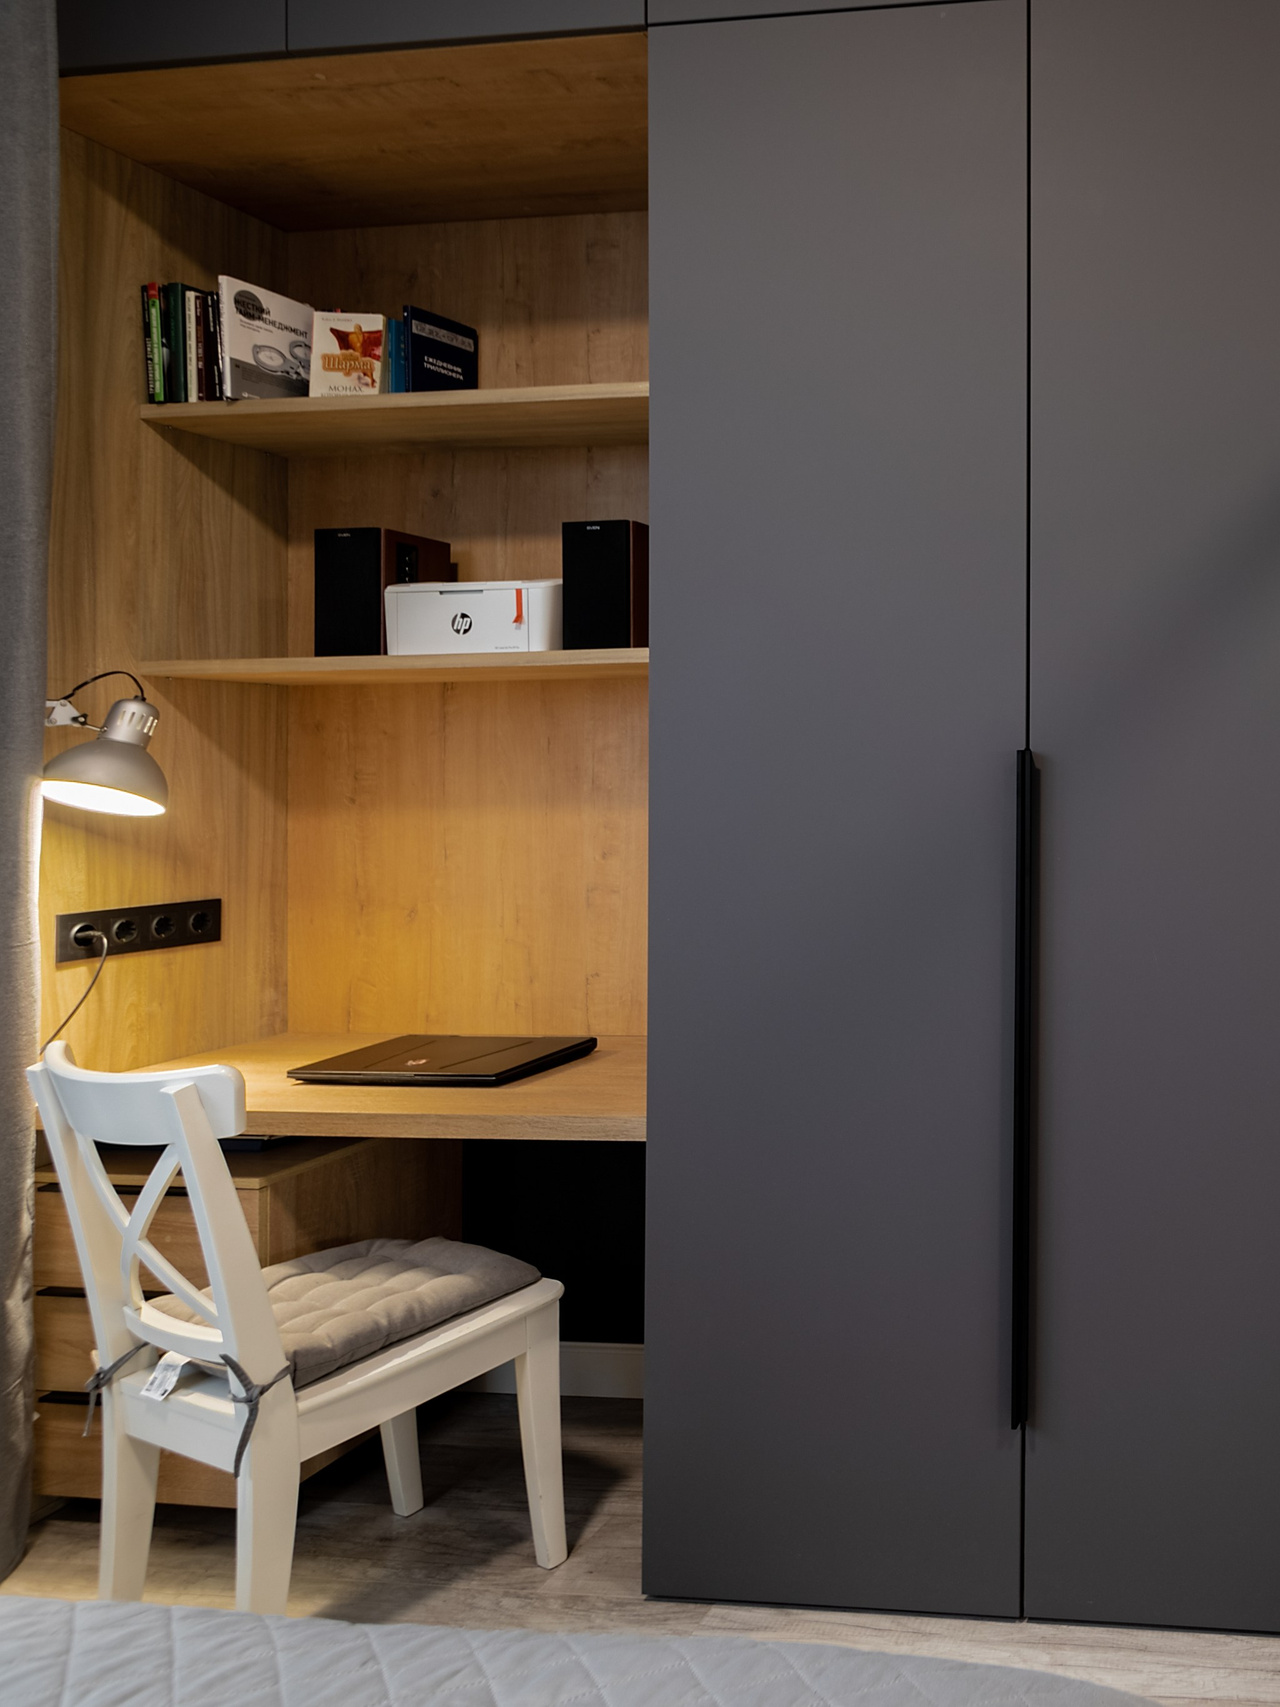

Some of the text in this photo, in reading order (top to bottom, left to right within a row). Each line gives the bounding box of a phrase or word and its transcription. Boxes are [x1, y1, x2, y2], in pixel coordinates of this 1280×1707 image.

[235, 306, 309, 339] ТАЙМ-МЕНЕДЖМЕНТ
[324, 356, 372, 373] Шарма
[452, 612, 472, 635] hp
